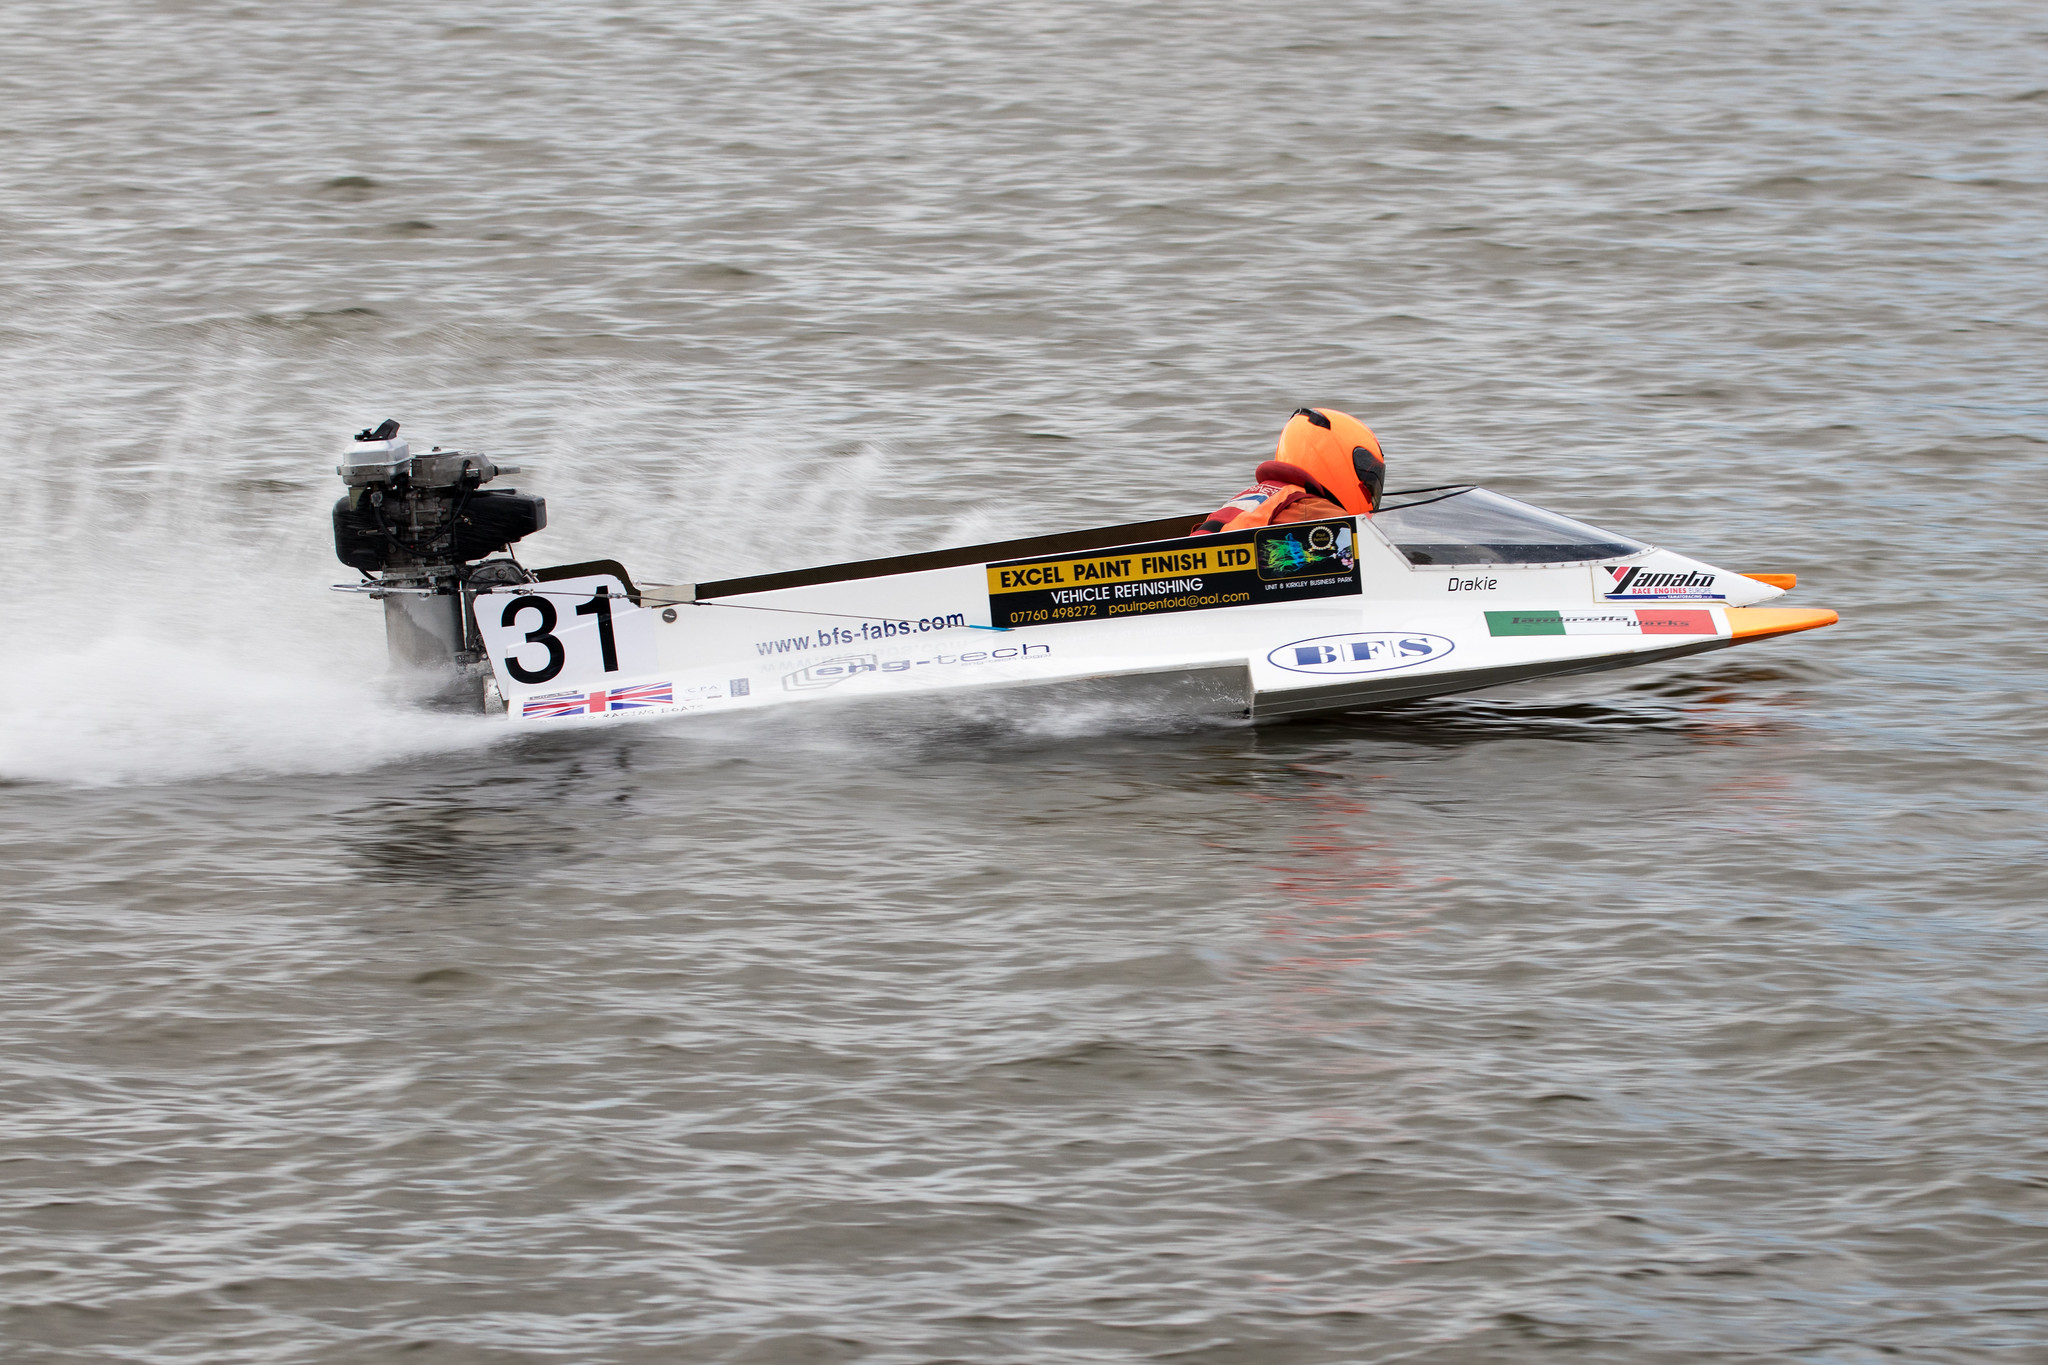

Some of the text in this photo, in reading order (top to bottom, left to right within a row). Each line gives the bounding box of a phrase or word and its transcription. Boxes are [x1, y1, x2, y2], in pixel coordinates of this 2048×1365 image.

[1000, 548, 1251, 588] EXCEL PAINT FINISH LTD
[1264, 583, 1278, 591] UNIT
[1285, 581, 1308, 589] KIRKLEY
[1309, 577, 1336, 587] BUSINESS
[1337, 576, 1353, 584] PARK
[1447, 575, 1498, 592] Drakie
[1603, 566, 1716, 594] Yamato
[1050, 577, 1204, 604] VEHICLE REFINISHING
[1010, 592, 1250, 623] 07760 498272 paulrpenfold@aol.com
[500, 585, 619, 684] 31
[756, 612, 965, 656] www.bfs-fabs.com
[815, 643, 1051, 674] eng-tech
